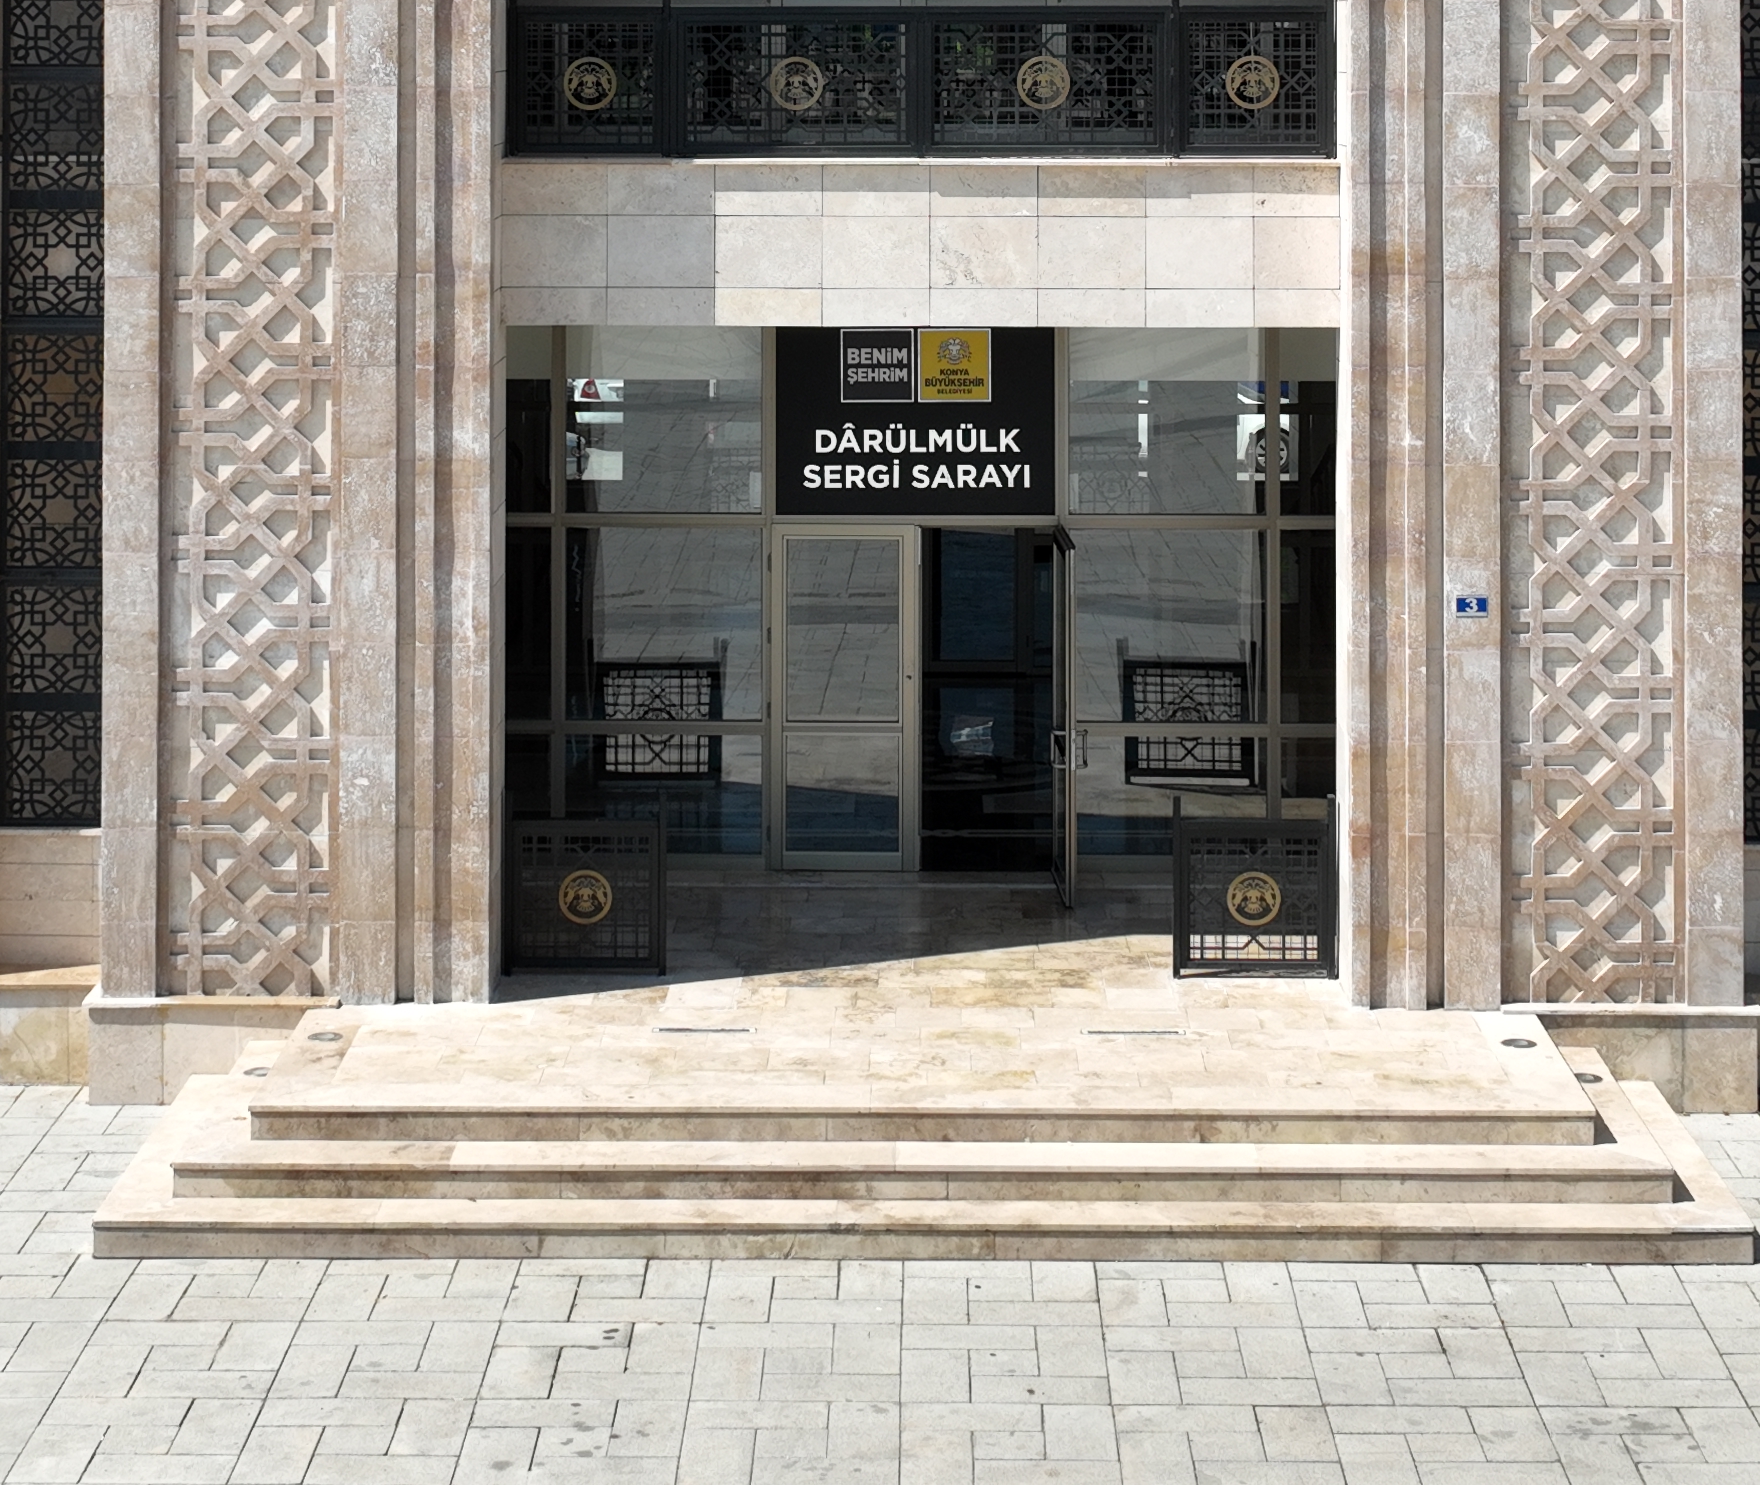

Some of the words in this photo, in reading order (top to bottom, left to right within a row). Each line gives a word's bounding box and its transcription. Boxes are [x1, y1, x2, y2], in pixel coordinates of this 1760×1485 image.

[939, 368, 970, 376] KONYA
[815, 422, 1021, 453] DÂRÜLMÜLK
[803, 459, 900, 489] SERGİ
[911, 464, 1030, 489] SARAYI
[1465, 597, 1478, 613] 3
